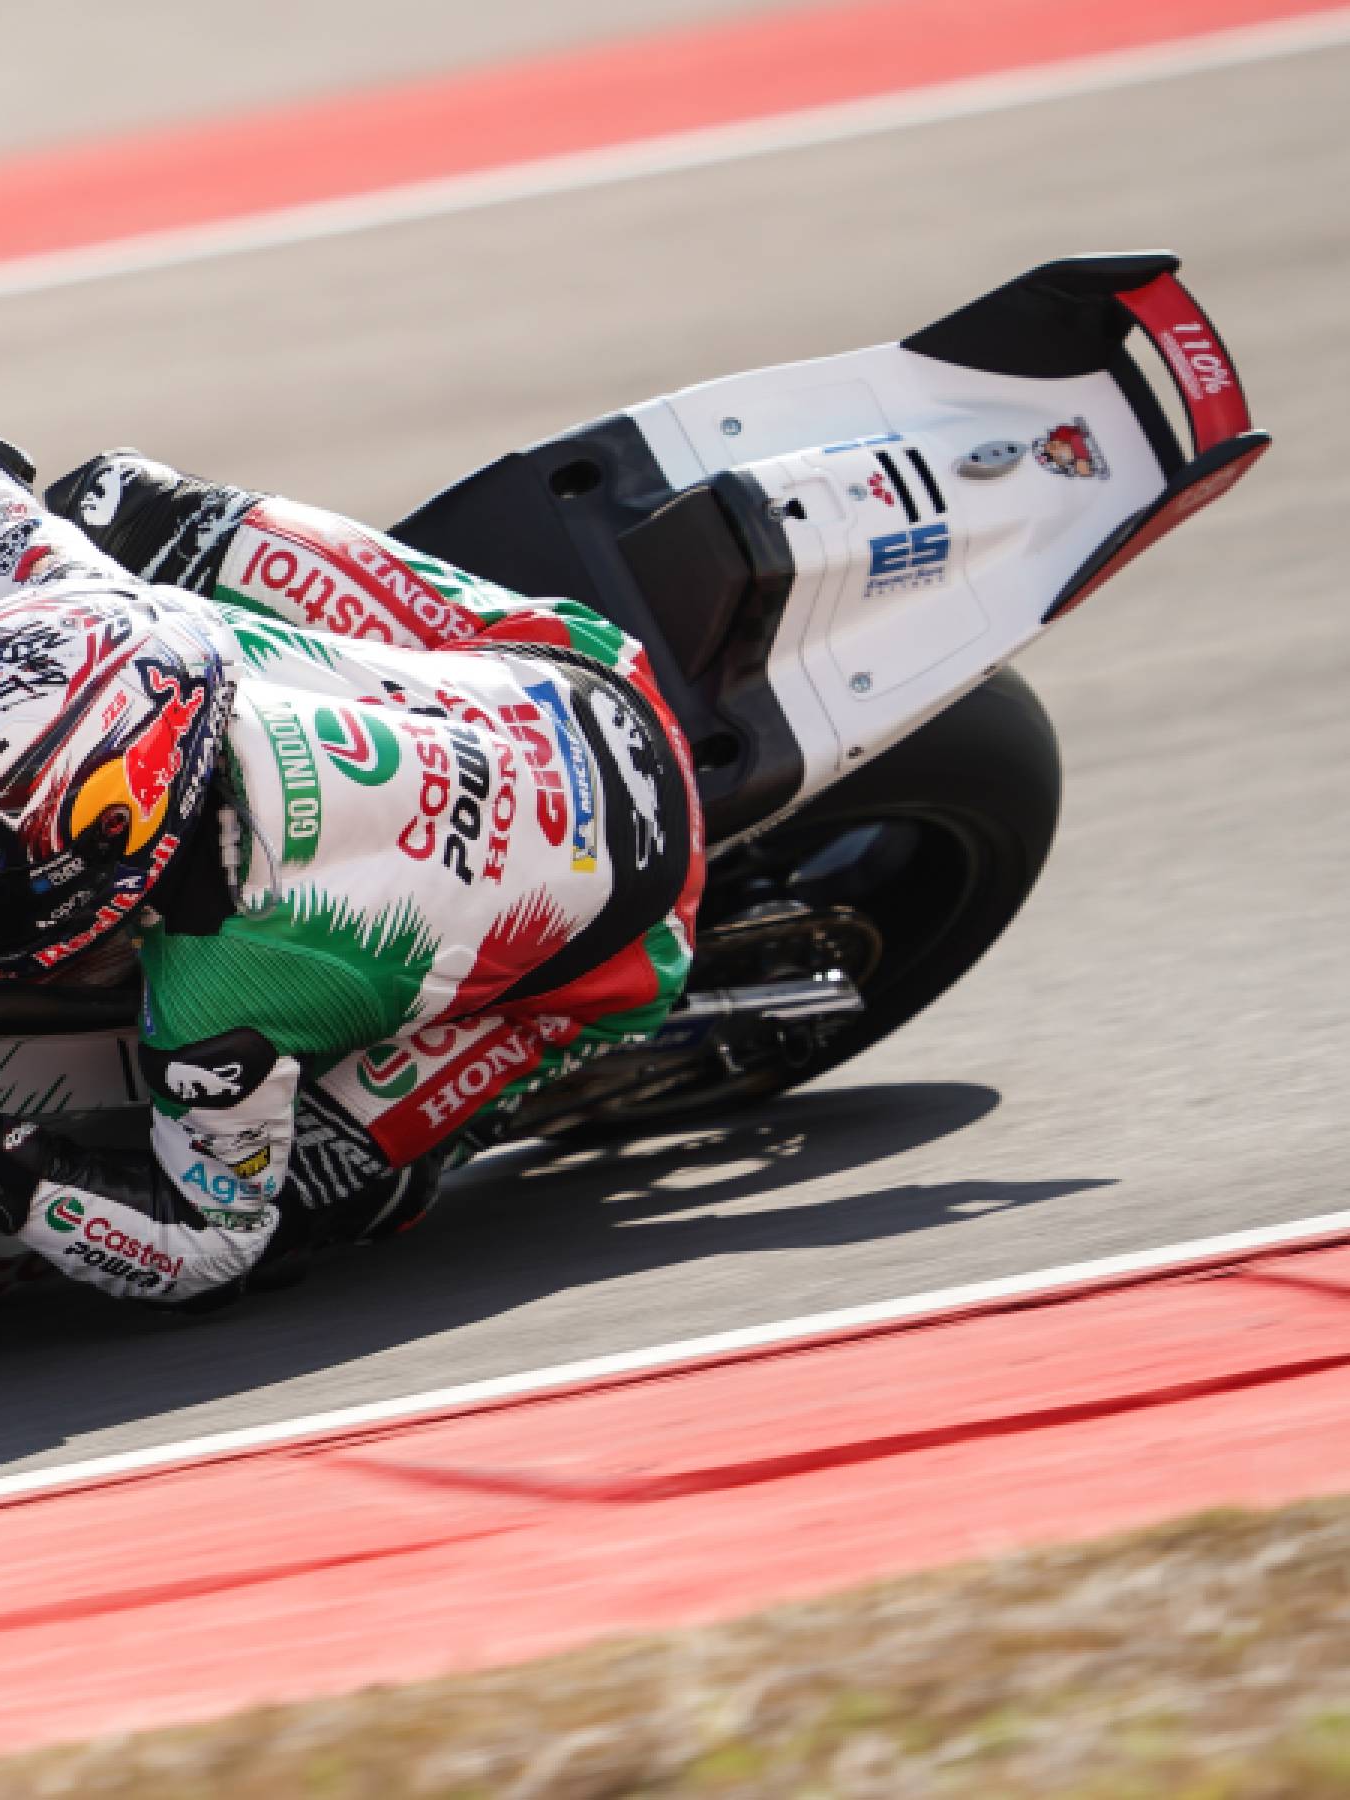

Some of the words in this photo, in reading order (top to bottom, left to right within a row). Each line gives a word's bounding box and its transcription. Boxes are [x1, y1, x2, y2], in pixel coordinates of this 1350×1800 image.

[1172, 322, 1231, 394] 110%
[240, 540, 393, 645] astrol
[350, 547, 476, 641] HOND
[498, 703, 568, 847] GIVI
[290, 799, 319, 840] GO
[83, 1217, 185, 1280] Castrol
